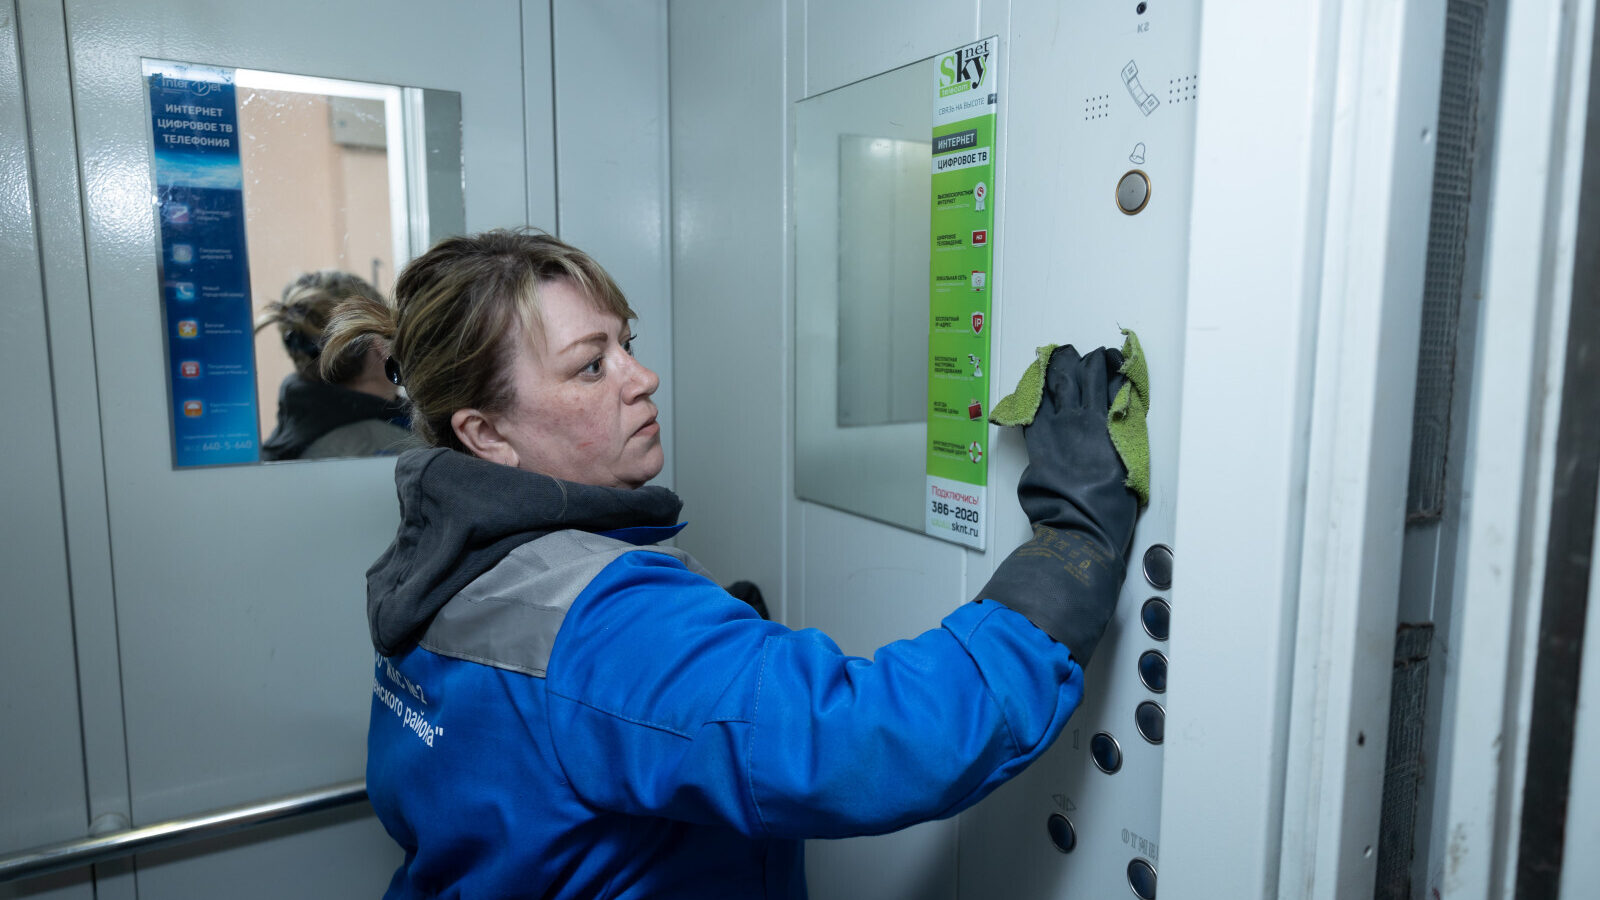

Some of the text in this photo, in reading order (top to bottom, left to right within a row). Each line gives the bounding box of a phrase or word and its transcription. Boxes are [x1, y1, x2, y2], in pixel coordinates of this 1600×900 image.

[965, 41, 989, 58] net
[165, 104, 223, 117] ИНТЕРНЕТ
[158, 119, 233, 133] ЦИФРОВОЕ ТВ
[163, 134, 230, 148] ТЕЛЕФОНИЯ
[938, 133, 975, 150] ИНТЕРНЕТ
[937, 151, 988, 170] ЦИФРОВОЕ ТВ
[931, 500, 979, 524] 386-2020
[1121, 828, 1160, 861] ОТМЕ
